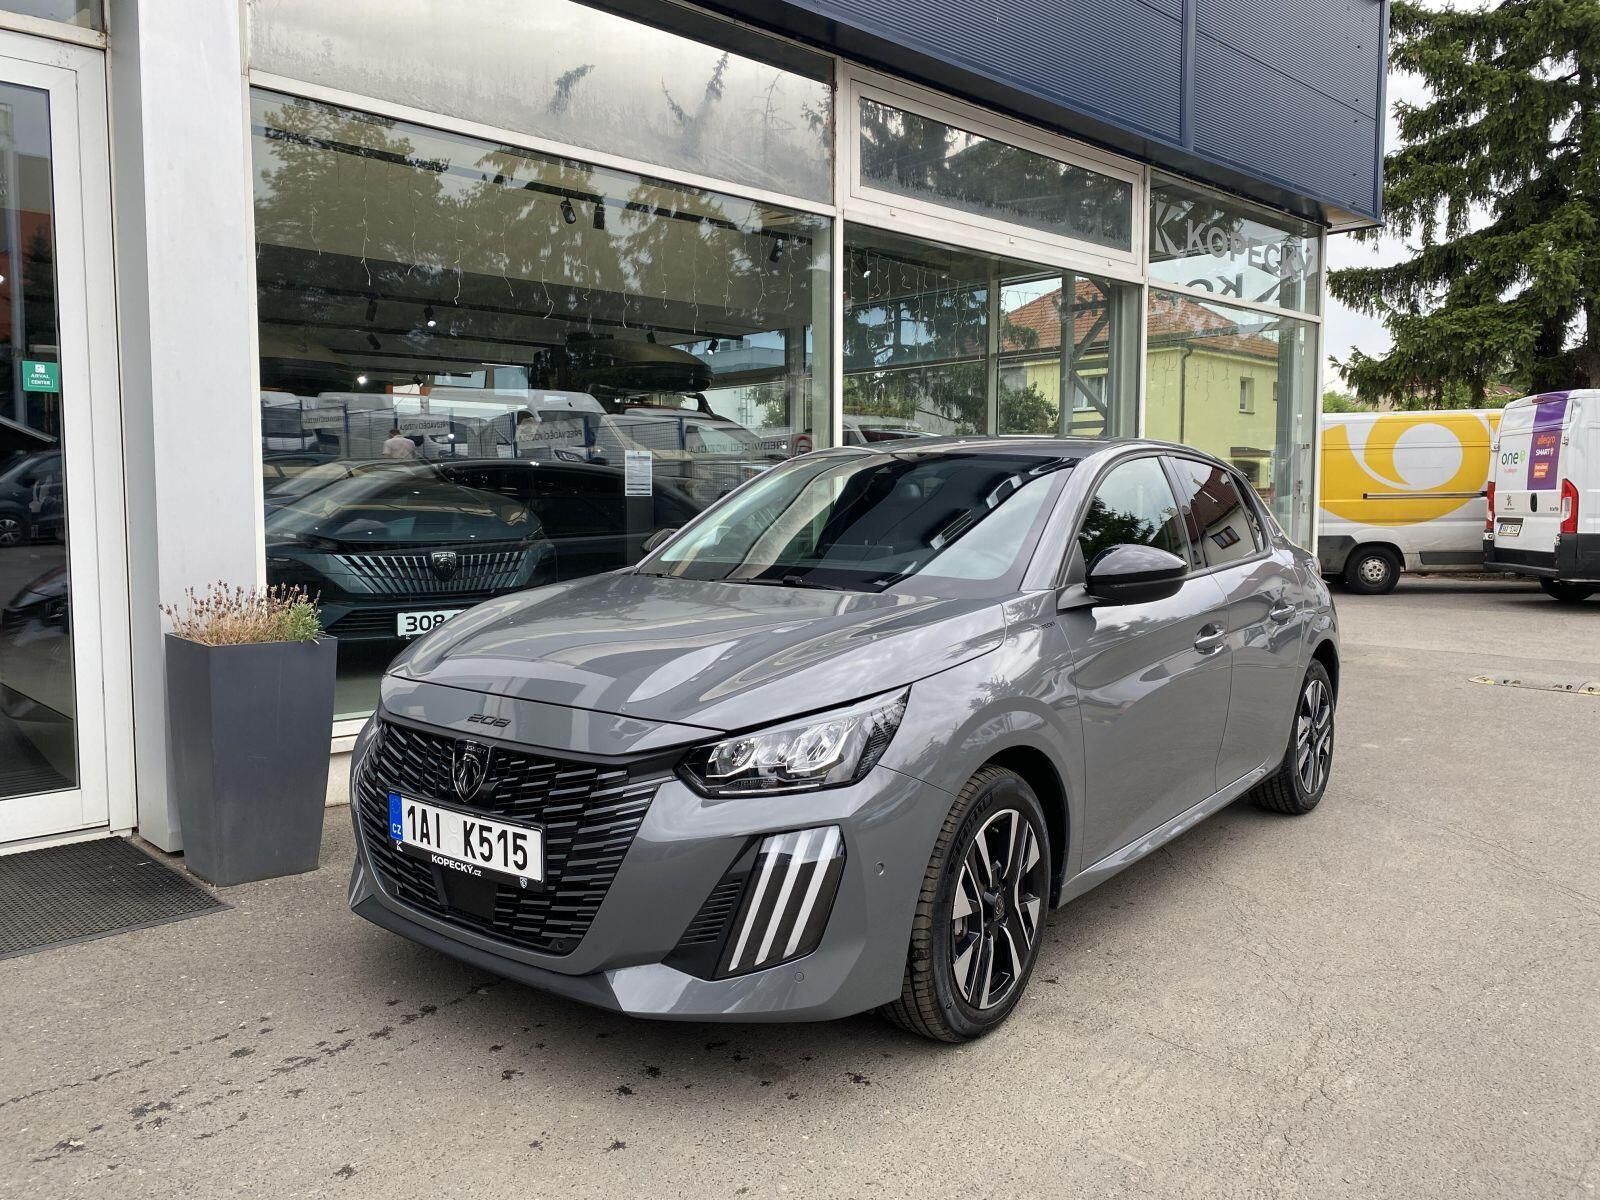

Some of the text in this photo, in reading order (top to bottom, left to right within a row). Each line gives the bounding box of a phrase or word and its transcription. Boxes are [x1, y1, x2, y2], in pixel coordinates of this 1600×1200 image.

[1187, 218, 1314, 281] KOPECKÝ
[1501, 452, 1519, 466] one
[405, 614, 445, 632] 308
[467, 713, 512, 728] 208
[392, 805, 528, 871] CZ 1AI K515
